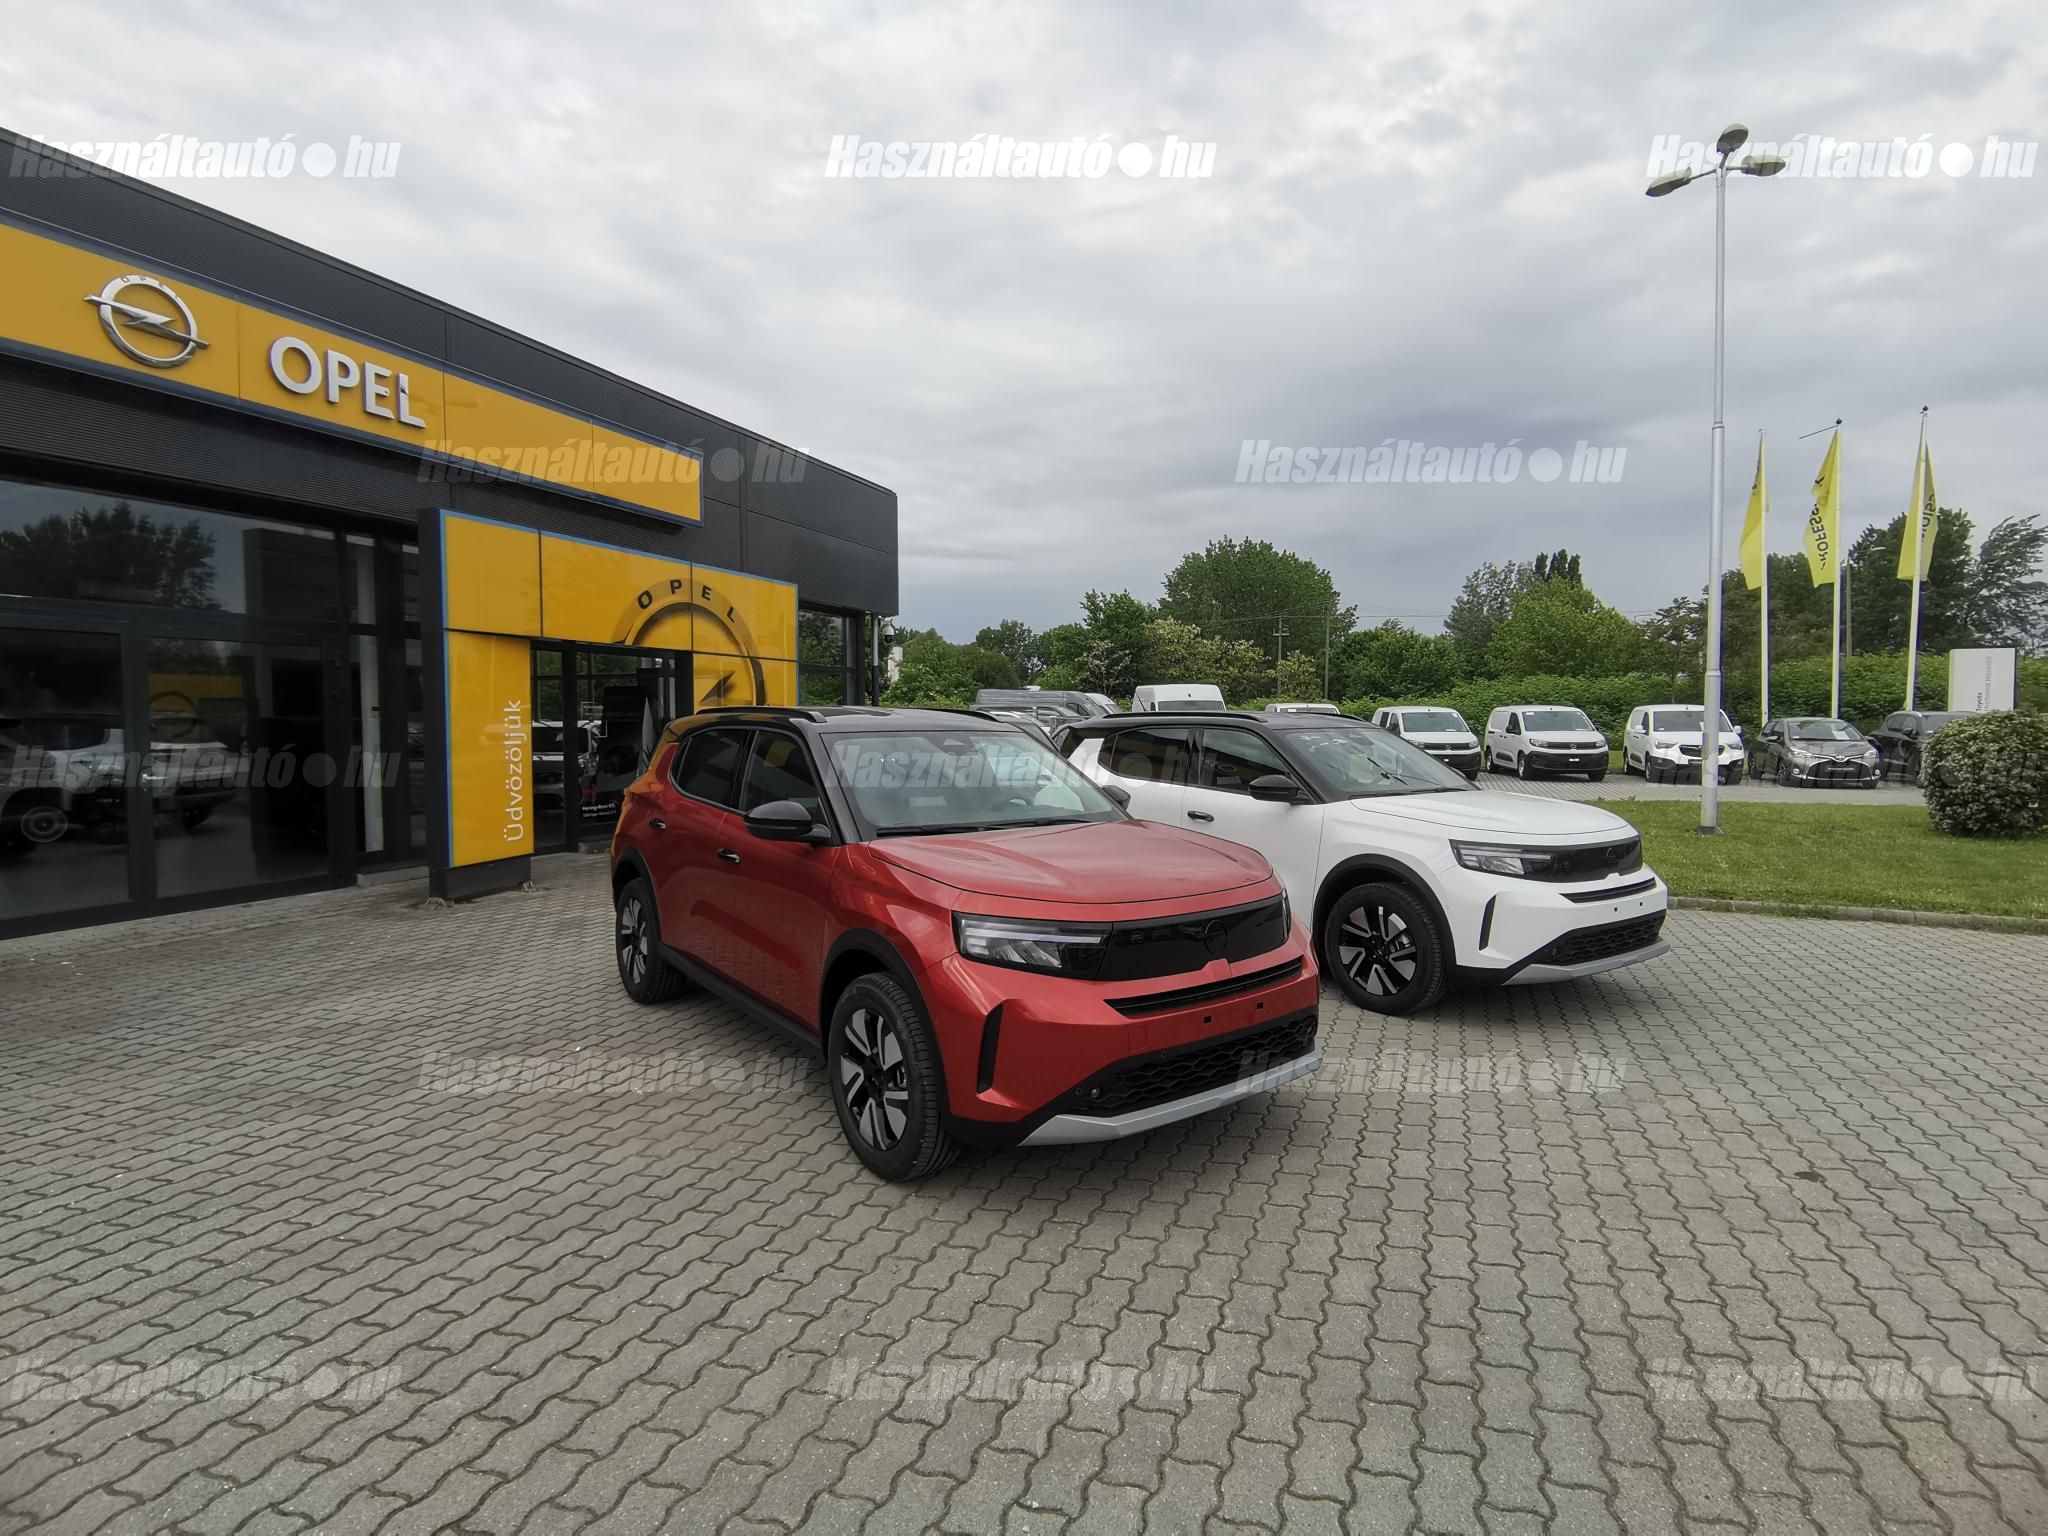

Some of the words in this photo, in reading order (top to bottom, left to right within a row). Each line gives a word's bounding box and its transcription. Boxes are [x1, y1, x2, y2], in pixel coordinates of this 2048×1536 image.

[269, 335, 427, 429] OPEL
[636, 578, 738, 624] OPEL
[503, 699, 527, 842] Üdvözöljük
